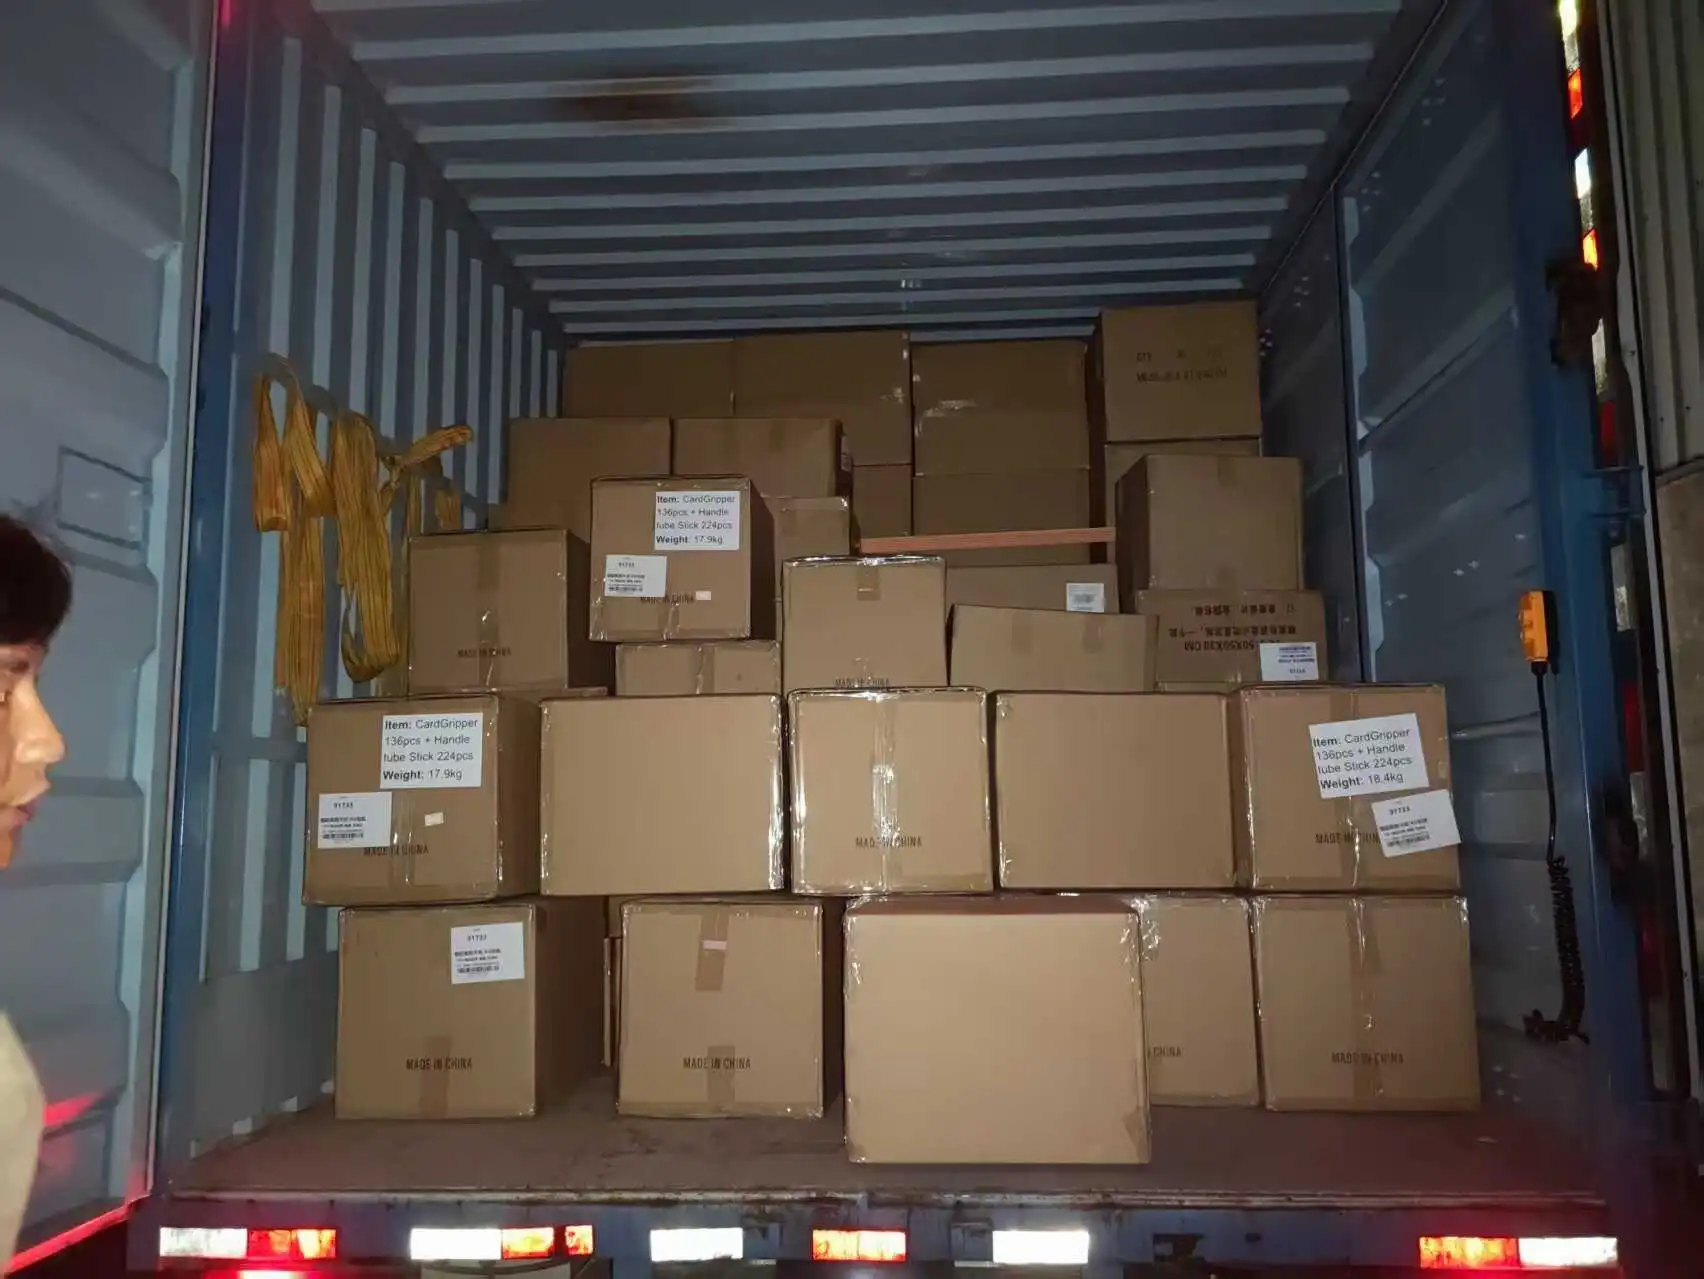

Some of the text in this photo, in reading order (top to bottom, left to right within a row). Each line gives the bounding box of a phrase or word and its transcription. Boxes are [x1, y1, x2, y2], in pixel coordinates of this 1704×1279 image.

[385, 719, 478, 730] Item: CardGripper
[385, 736, 421, 747] 136pcs
[434, 734, 470, 744] Handle
[1345, 729, 1410, 744] CardGripper
[409, 751, 434, 762] Stick
[437, 751, 474, 762] 224pcs
[1317, 750, 1354, 761] 136pcs
[1367, 743, 1406, 755] Handle
[1344, 759, 1370, 771] Stick
[1373, 756, 1413, 768] 224pcs
[383, 769, 463, 782] Weight: 17.9kg
[1320, 777, 1364, 790] Weight:
[406, 1058, 431, 1070] MADE
[445, 1057, 472, 1069] CHINA
[683, 1057, 751, 1069] MADE IN CHINA
